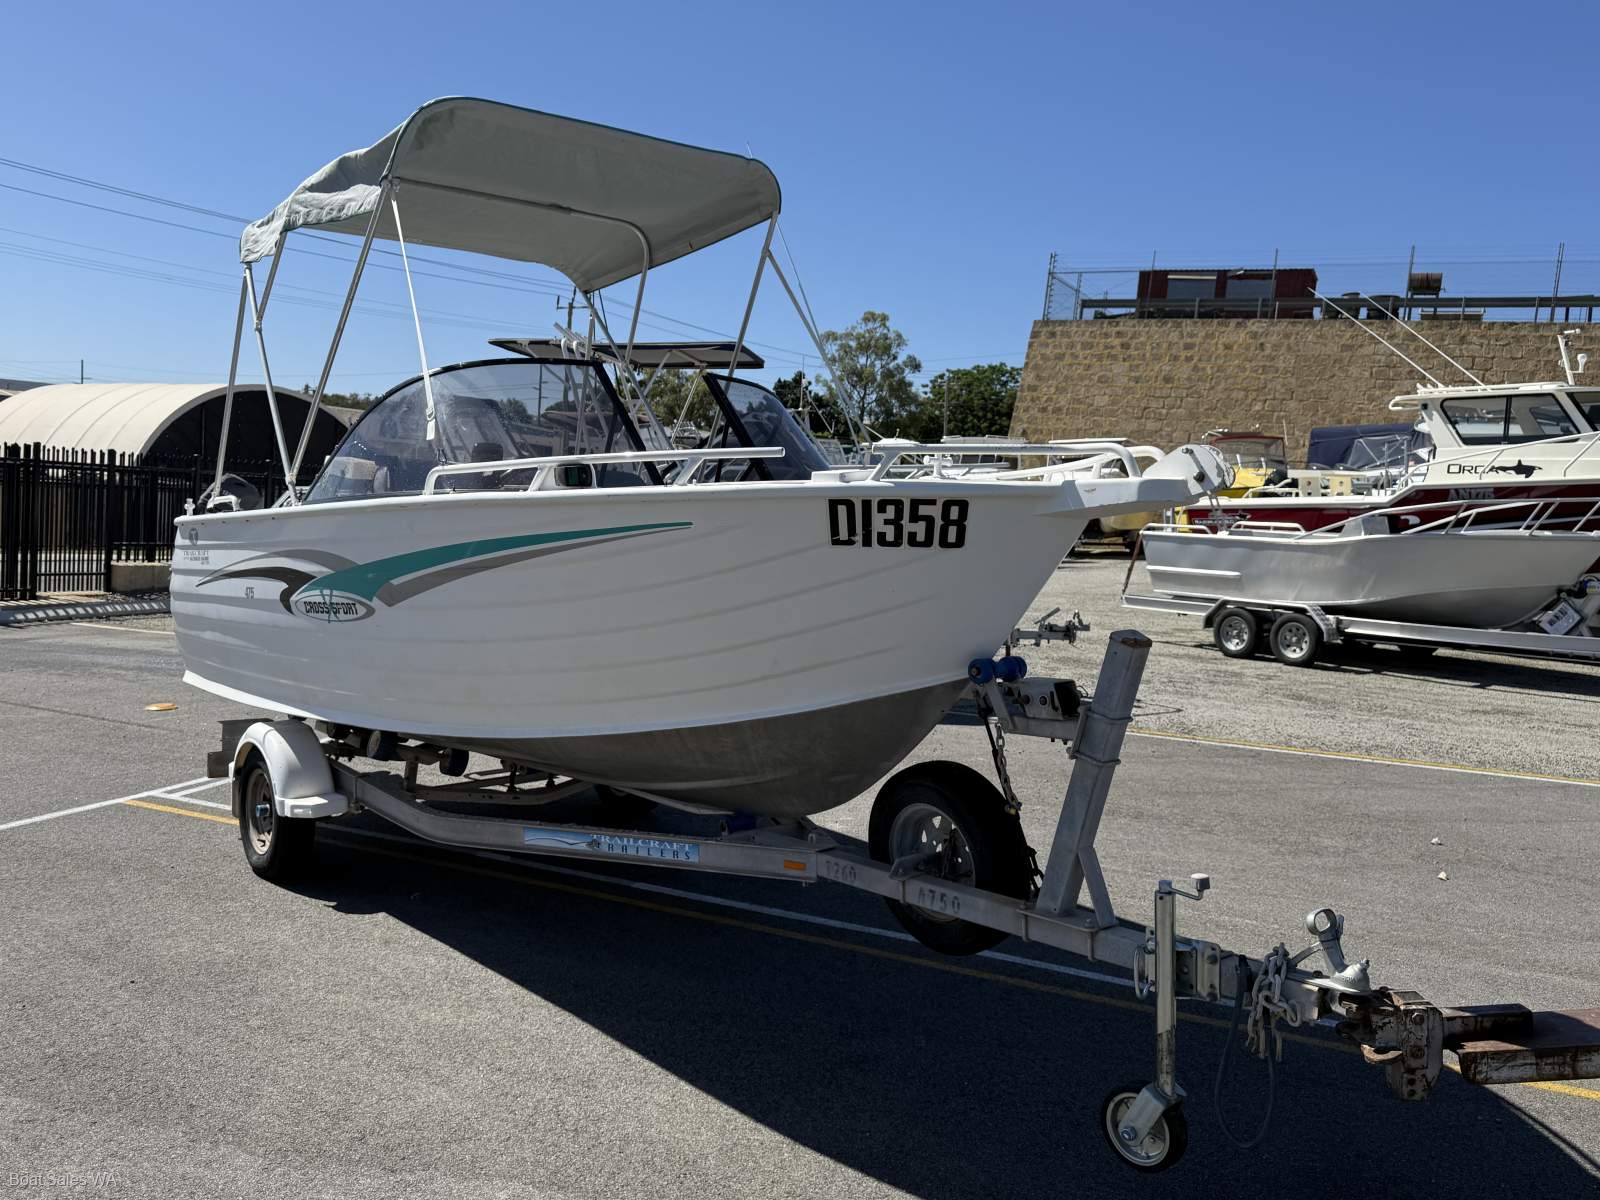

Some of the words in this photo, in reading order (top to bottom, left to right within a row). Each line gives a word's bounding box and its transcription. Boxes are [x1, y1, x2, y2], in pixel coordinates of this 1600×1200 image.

[1447, 464, 1499, 474] ORCA
[828, 498, 969, 548] DI358
[304, 601, 330, 615] CROSS
[590, 833, 693, 852] TRAILCRAFT
[596, 840, 691, 861] TRAILERS
